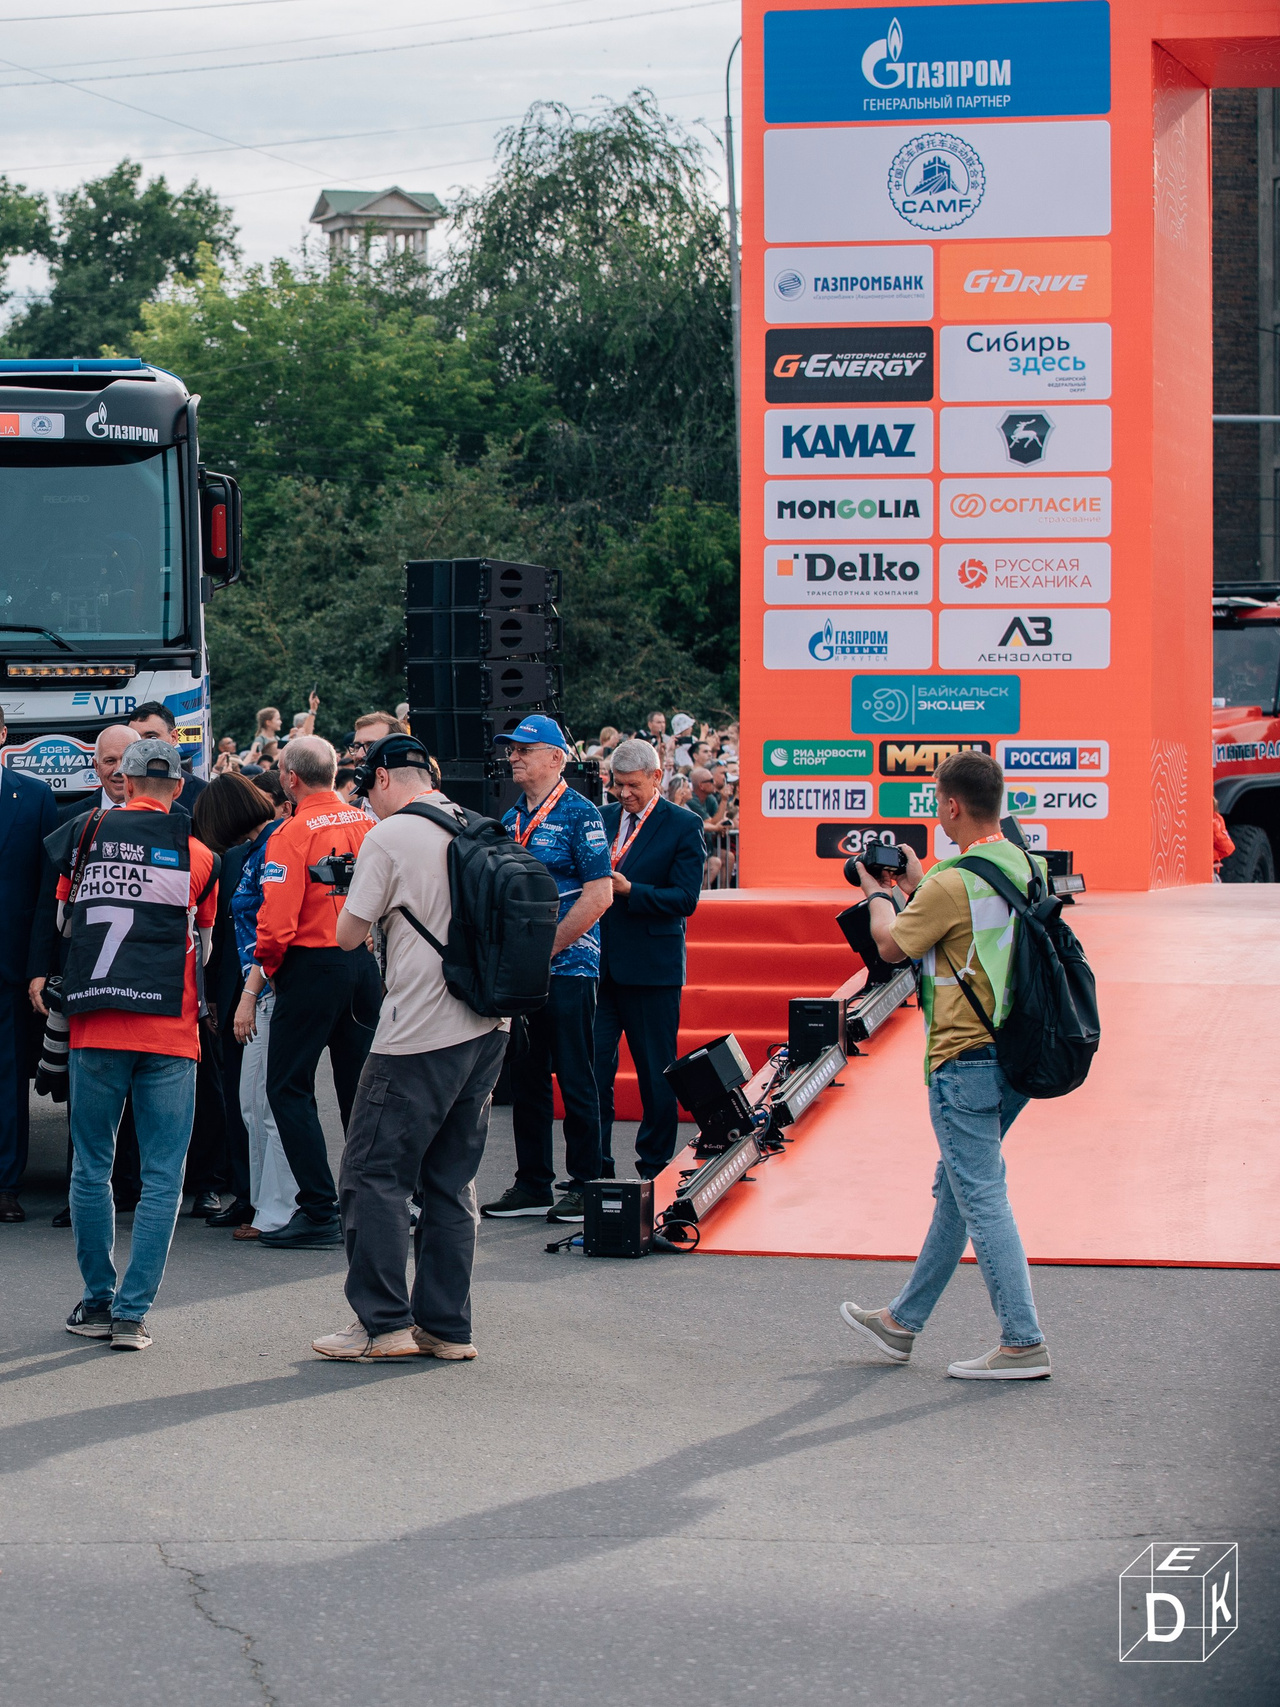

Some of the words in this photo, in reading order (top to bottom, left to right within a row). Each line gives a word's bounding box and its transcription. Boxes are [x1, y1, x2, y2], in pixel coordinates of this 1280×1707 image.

[907, 59, 1011, 88] ГАЗПРОМ
[863, 95, 952, 111] ГЕНЕРАЛЬНЫЙ
[957, 95, 1011, 109] ПАРТНЕР
[902, 199, 971, 213] CAMF
[814, 275, 924, 292] ГАЗПРОМБАНК
[966, 331, 1070, 356] Сибирь
[1008, 356, 1086, 375] здесь
[109, 425, 158, 443] ГАЗПРОМ
[782, 423, 916, 458] KAMAZ
[777, 499, 920, 519] MONGOLIA
[990, 497, 1101, 512] СОГЛАСИЕ
[1038, 515, 1101, 523] страхование
[804, 553, 920, 582] Delko
[994, 558, 1080, 572] РУССКАЯ
[994, 574, 1092, 589] МЕХАНИКА
[835, 631, 888, 644] ГАЗПРОМ
[977, 653, 1072, 662] ЛЕНЗОЛОТО
[917, 686, 1009, 697] БАЙКАЛЬСК
[93, 696, 137, 715] VTB
[917, 700, 986, 711] ЭКО.ЦЕХ
[40, 746, 70, 754] 2025
[793, 749, 814, 758] РИА
[816, 749, 866, 758] НОВОСТИ
[887, 744, 974, 771] МАТ
[11, 756, 56, 767] SILK
[59, 755, 95, 767] WAY
[792, 757, 827, 766] СПОРТ
[1010, 752, 1070, 765] РОССИЯ
[1080, 752, 1099, 765] 24
[769, 788, 840, 810] ИЗВЕСТИЯ
[1043, 793, 1097, 808] 2ГИС
[120, 842, 144, 853] SILK
[120, 852, 144, 861] WAY
[85, 865, 153, 883] FFICIAL
[80, 881, 142, 898] PHOTO
[86, 905, 134, 980] 7
[67, 986, 162, 1001] www.silkwayrally.com
